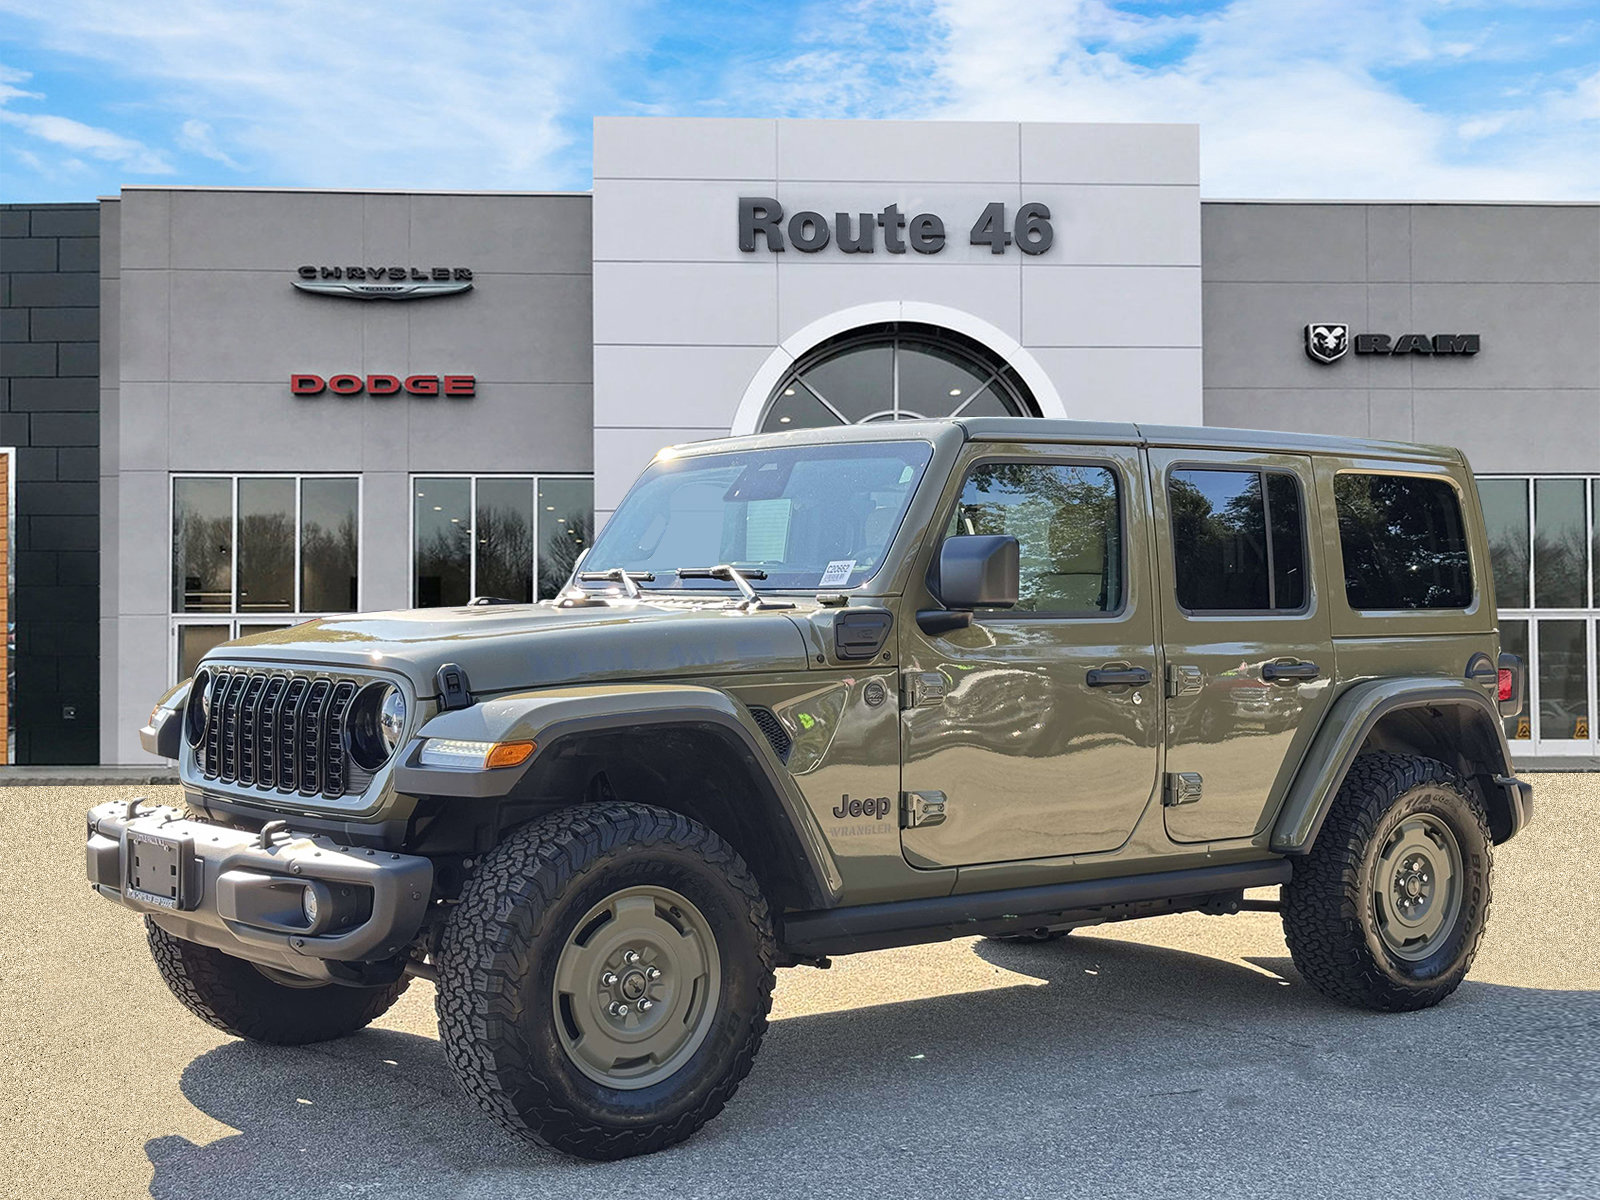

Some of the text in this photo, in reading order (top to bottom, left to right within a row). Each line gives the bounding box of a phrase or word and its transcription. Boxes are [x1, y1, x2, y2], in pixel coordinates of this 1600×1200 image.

[738, 197, 1054, 255] Route 46
[298, 265, 473, 281] CHRYSLER
[1354, 333, 1480, 356] RAM
[291, 373, 475, 396] DODGE
[833, 793, 891, 820] Jeep
[830, 823, 893, 838] WRANGLER
